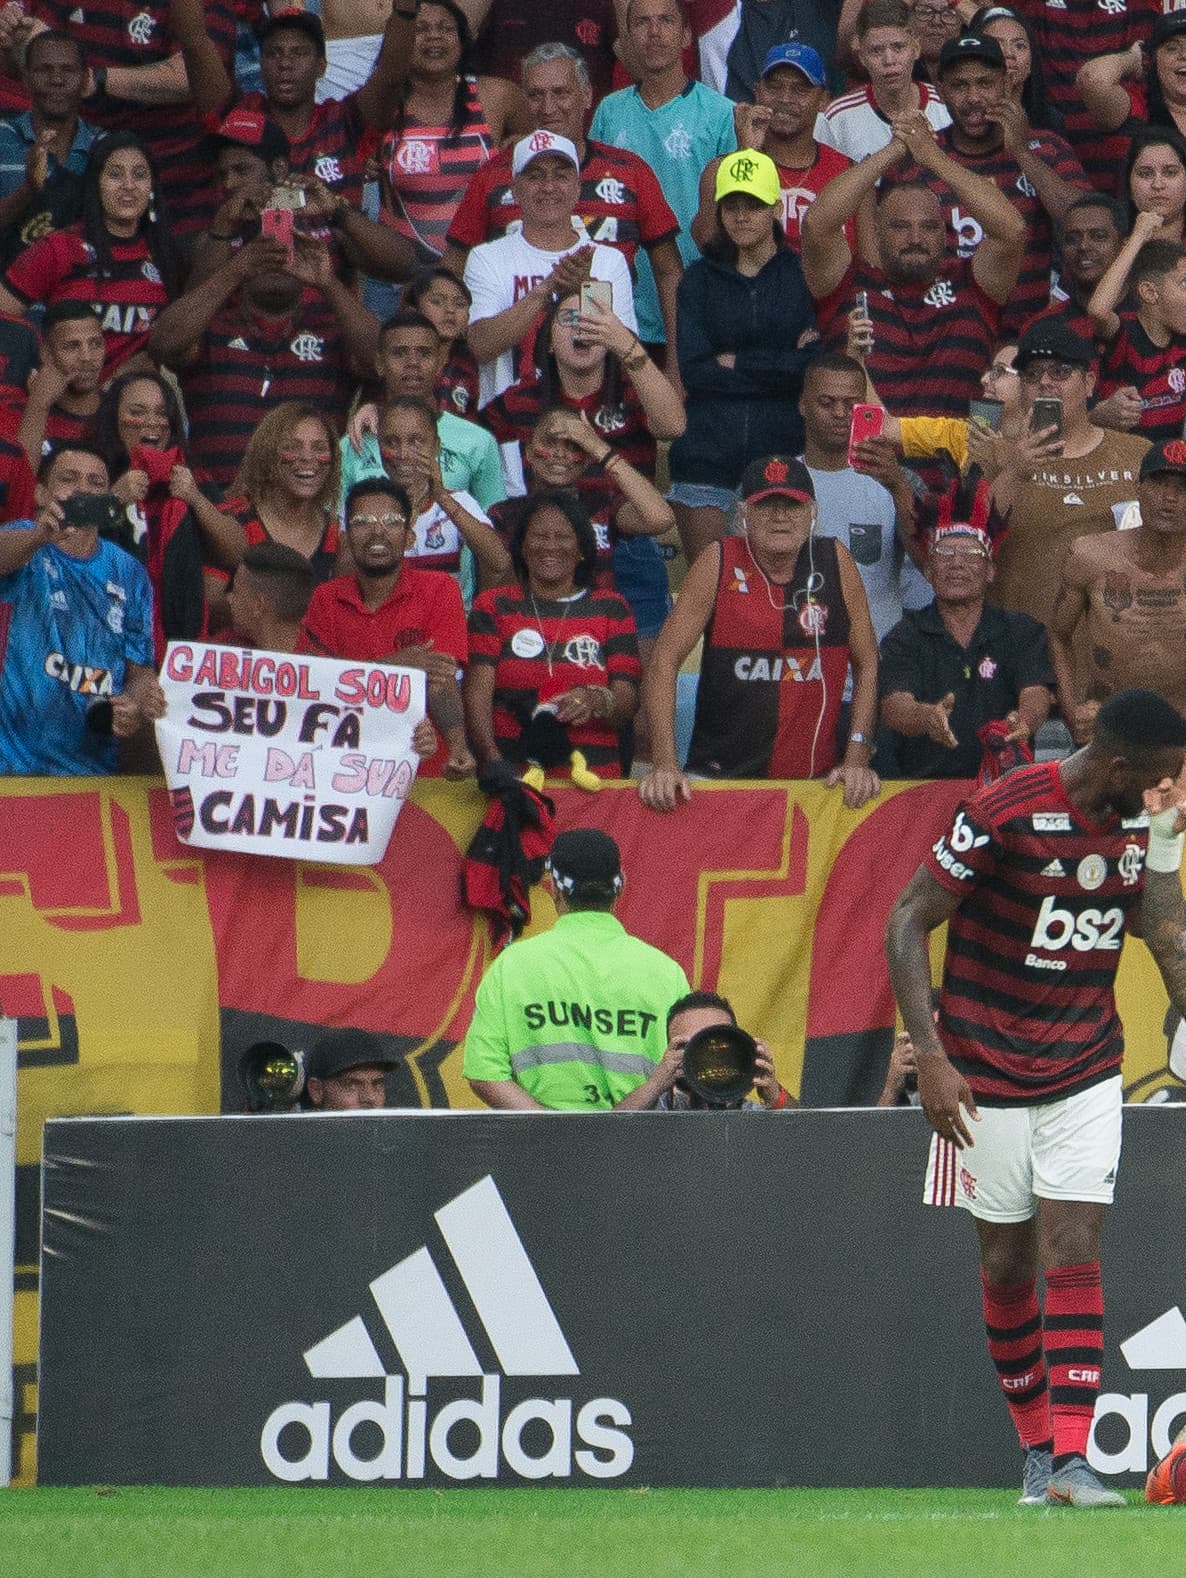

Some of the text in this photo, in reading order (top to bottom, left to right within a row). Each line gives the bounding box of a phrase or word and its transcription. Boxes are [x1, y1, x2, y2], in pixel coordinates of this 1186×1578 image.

[1032, 470, 1133, 484] IKSILVER
[334, 668, 411, 713] SOU
[734, 656, 824, 682] CAIXA
[187, 691, 287, 737] SEU
[177, 739, 240, 778] ME
[331, 753, 413, 800] SUA
[1031, 895, 1125, 951] bs2
[1024, 954, 1067, 970] Banco
[524, 1001, 658, 1039] SUNSET
[261, 1374, 635, 1481] adidas
